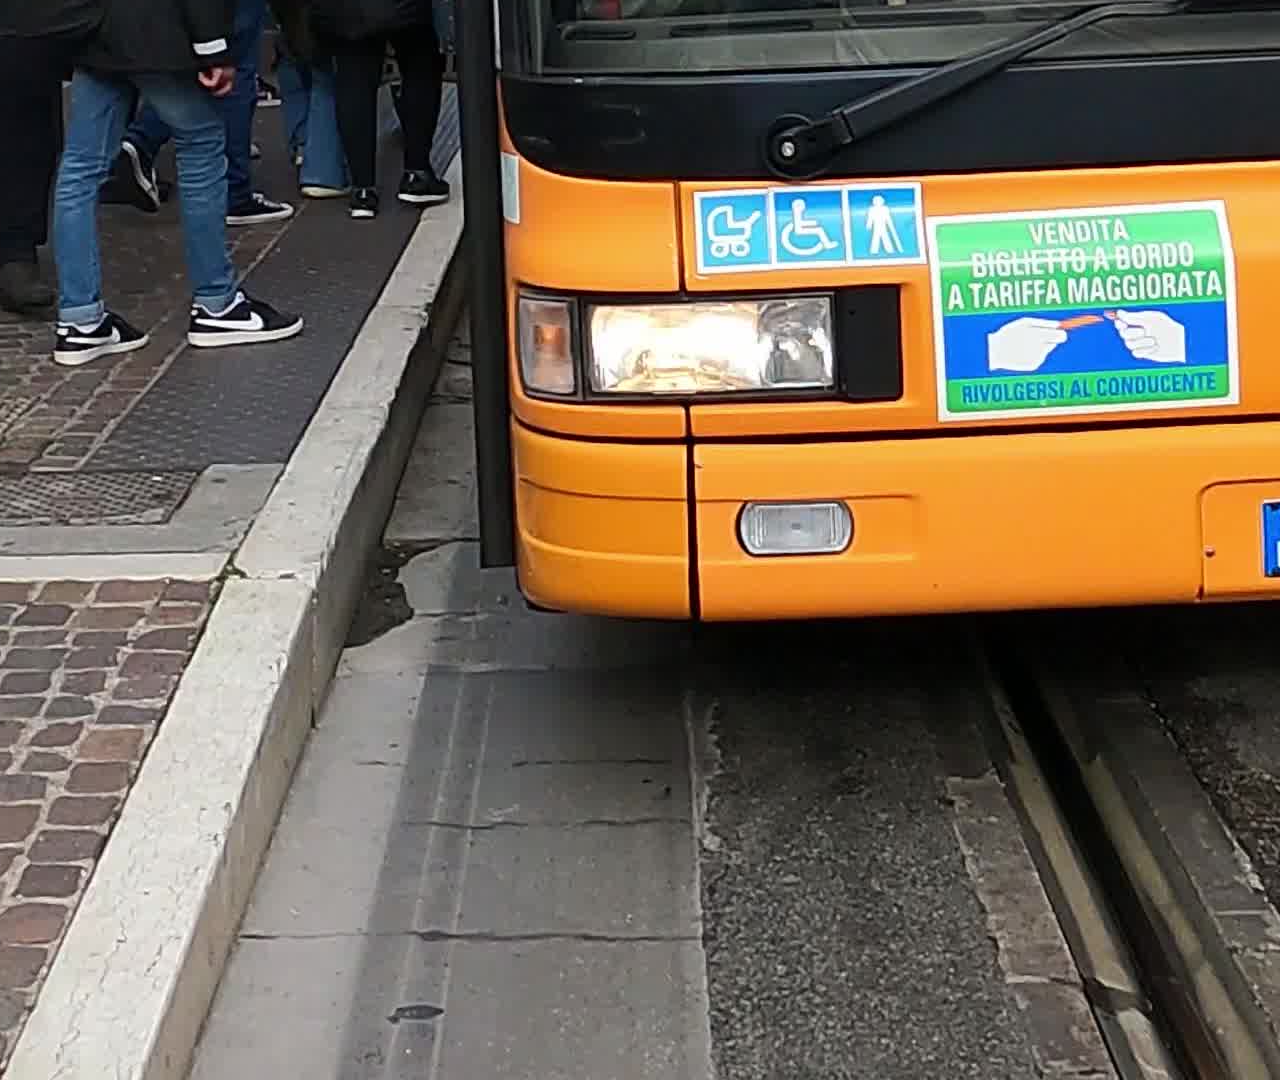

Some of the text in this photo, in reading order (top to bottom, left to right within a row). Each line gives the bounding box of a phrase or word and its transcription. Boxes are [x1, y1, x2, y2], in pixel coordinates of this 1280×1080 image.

[1027, 218, 1129, 247] VENDITA
[970, 240, 1194, 279] BIGLIETTO A BORDO
[947, 269, 1223, 311] A TARIFFA MAGGIORATA
[962, 371, 1217, 405] RIVOLGERSI AL CONDUCENTE
